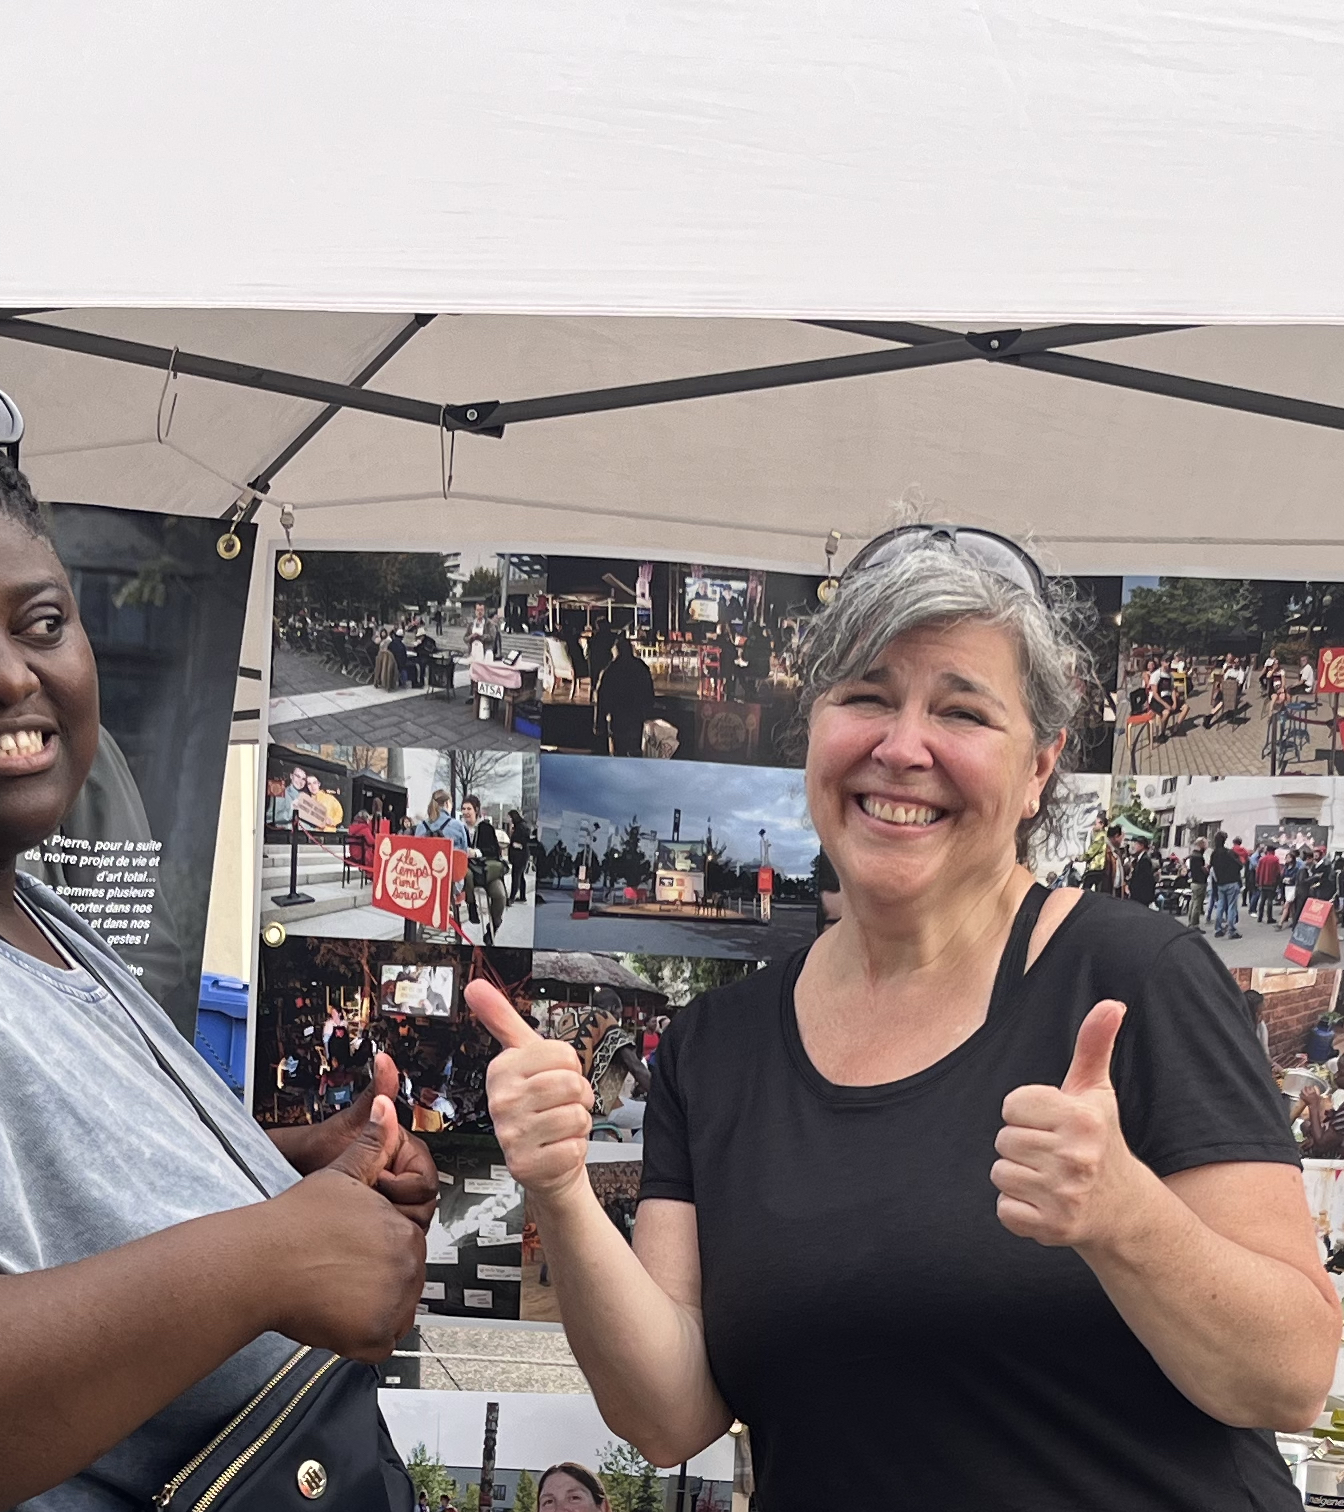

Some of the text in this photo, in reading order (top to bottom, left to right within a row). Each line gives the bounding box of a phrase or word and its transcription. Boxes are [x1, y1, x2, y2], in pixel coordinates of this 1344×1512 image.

[480, 684, 502, 696] ATSA
[52, 835, 91, 852] Pierre,
[94, 840, 121, 853] pour
[124, 840, 134, 851] la
[136, 841, 162, 852] suite
[24, 848, 160, 868] de notre projet de vie et
[96, 871, 121, 883] d'art
[56, 885, 155, 900] sommes plusieurs
[106, 902, 131, 913] dans
[132, 903, 153, 914] nos
[90, 916, 151, 930] et dans nos
[107, 932, 149, 947] gestes !
